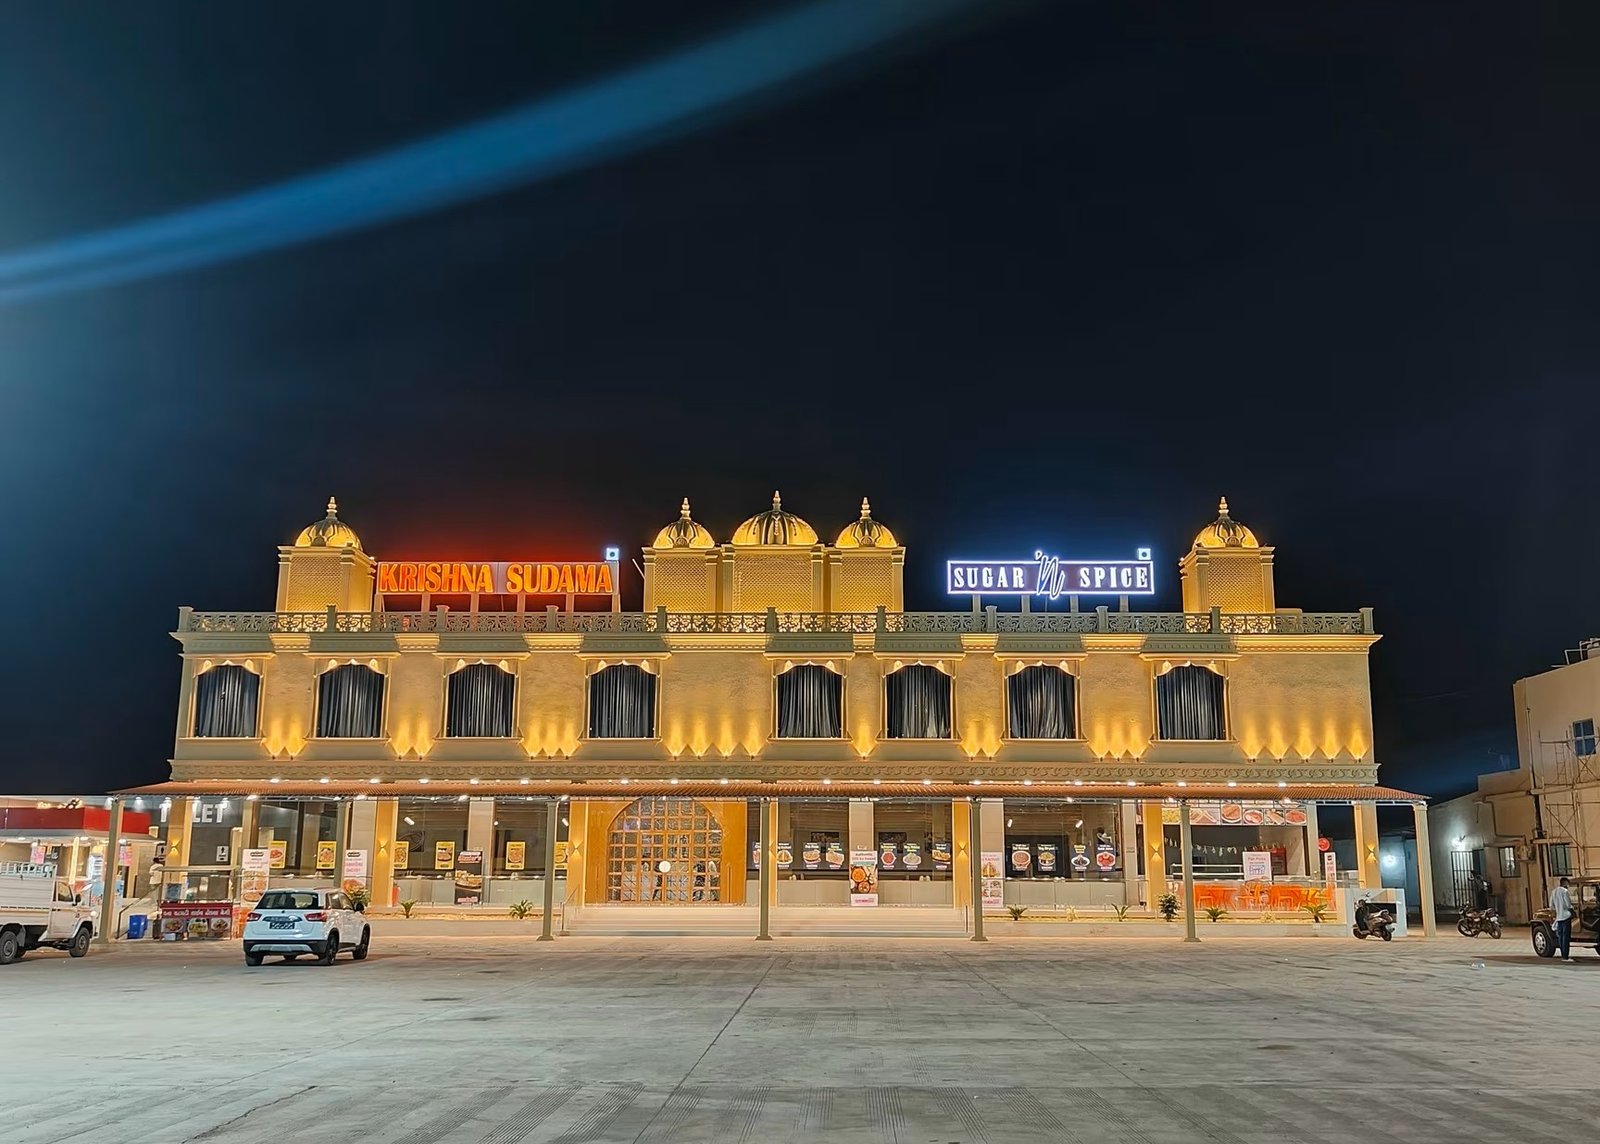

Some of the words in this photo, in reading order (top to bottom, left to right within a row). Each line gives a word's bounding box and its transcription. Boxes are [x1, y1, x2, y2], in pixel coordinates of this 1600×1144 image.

[379, 562, 494, 593] KRISHNA
[506, 564, 614, 594] SUDAMA
[954, 567, 1025, 588] SUGAR
[1080, 566, 1148, 588] SPICE
[159, 803, 227, 823] TLET
